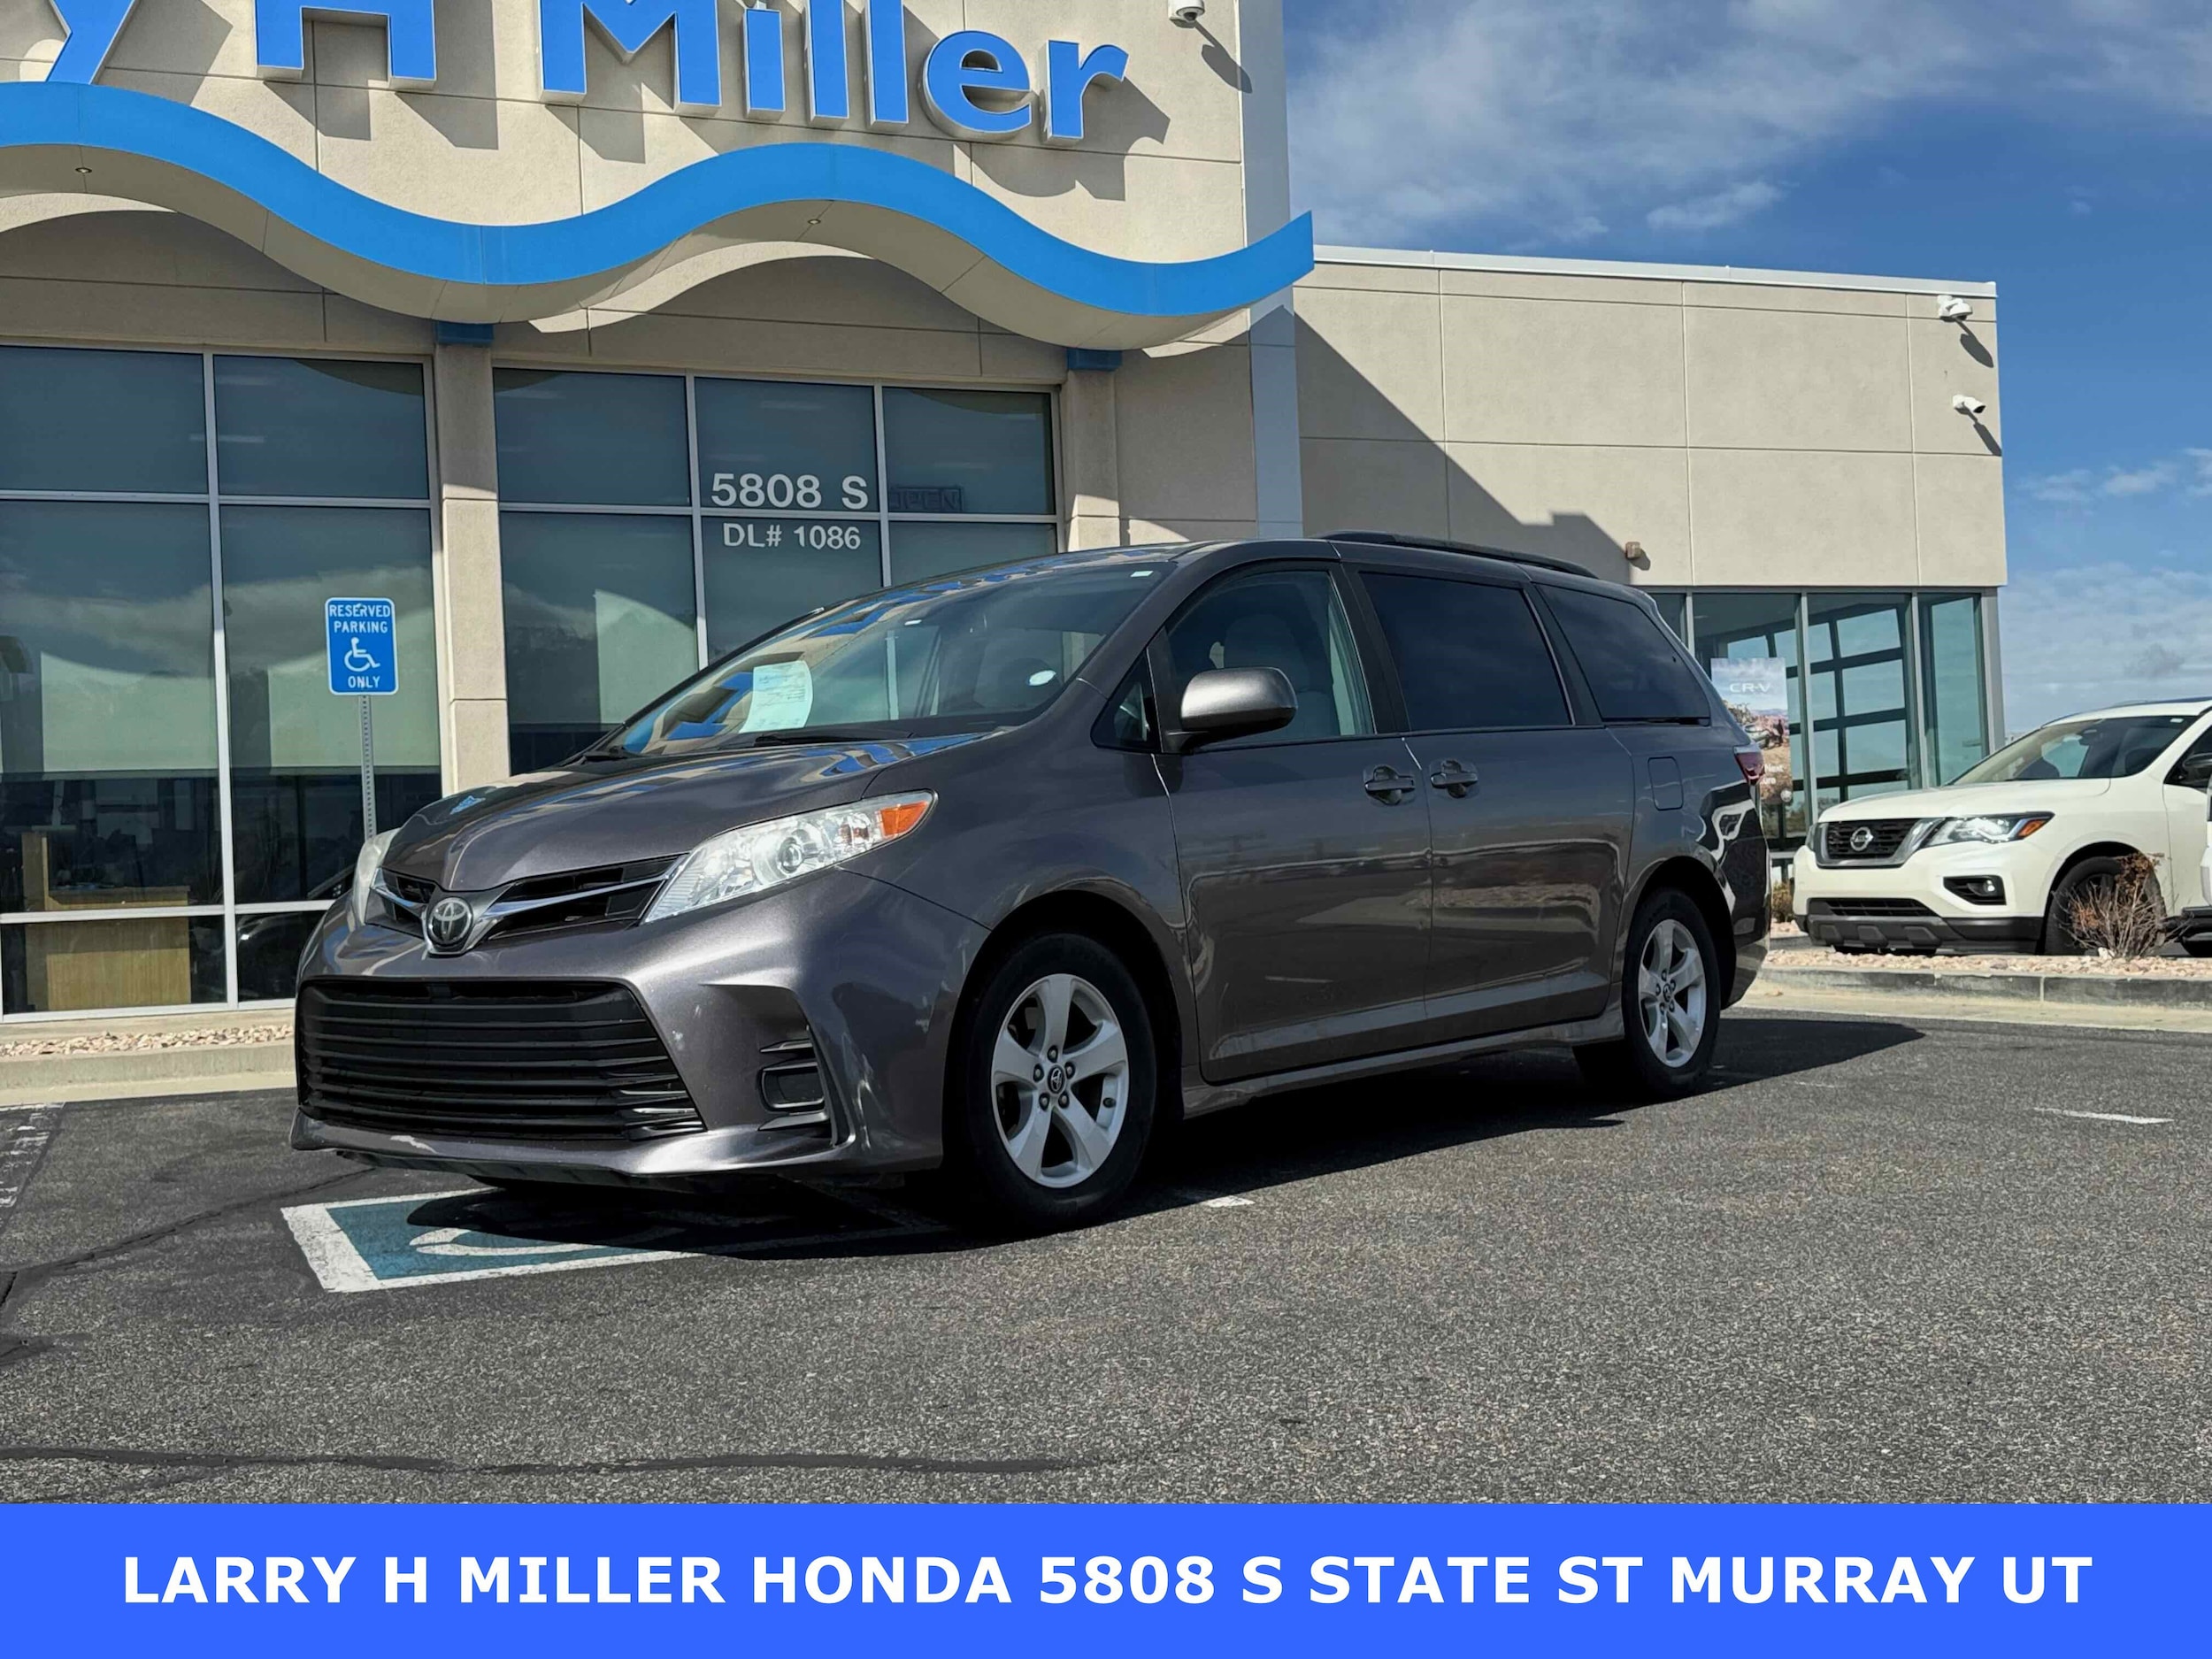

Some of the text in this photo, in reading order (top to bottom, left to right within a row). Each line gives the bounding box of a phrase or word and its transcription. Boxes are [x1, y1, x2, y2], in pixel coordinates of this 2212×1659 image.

[540, 0, 1129, 144] Miller
[711, 472, 869, 510] 5808 S
[723, 523, 861, 549] DL# 1086
[329, 603, 391, 617] RESERVED
[334, 620, 388, 634] PARKING
[348, 675, 380, 688] ONLY
[1730, 682, 1770, 694] CR-V
